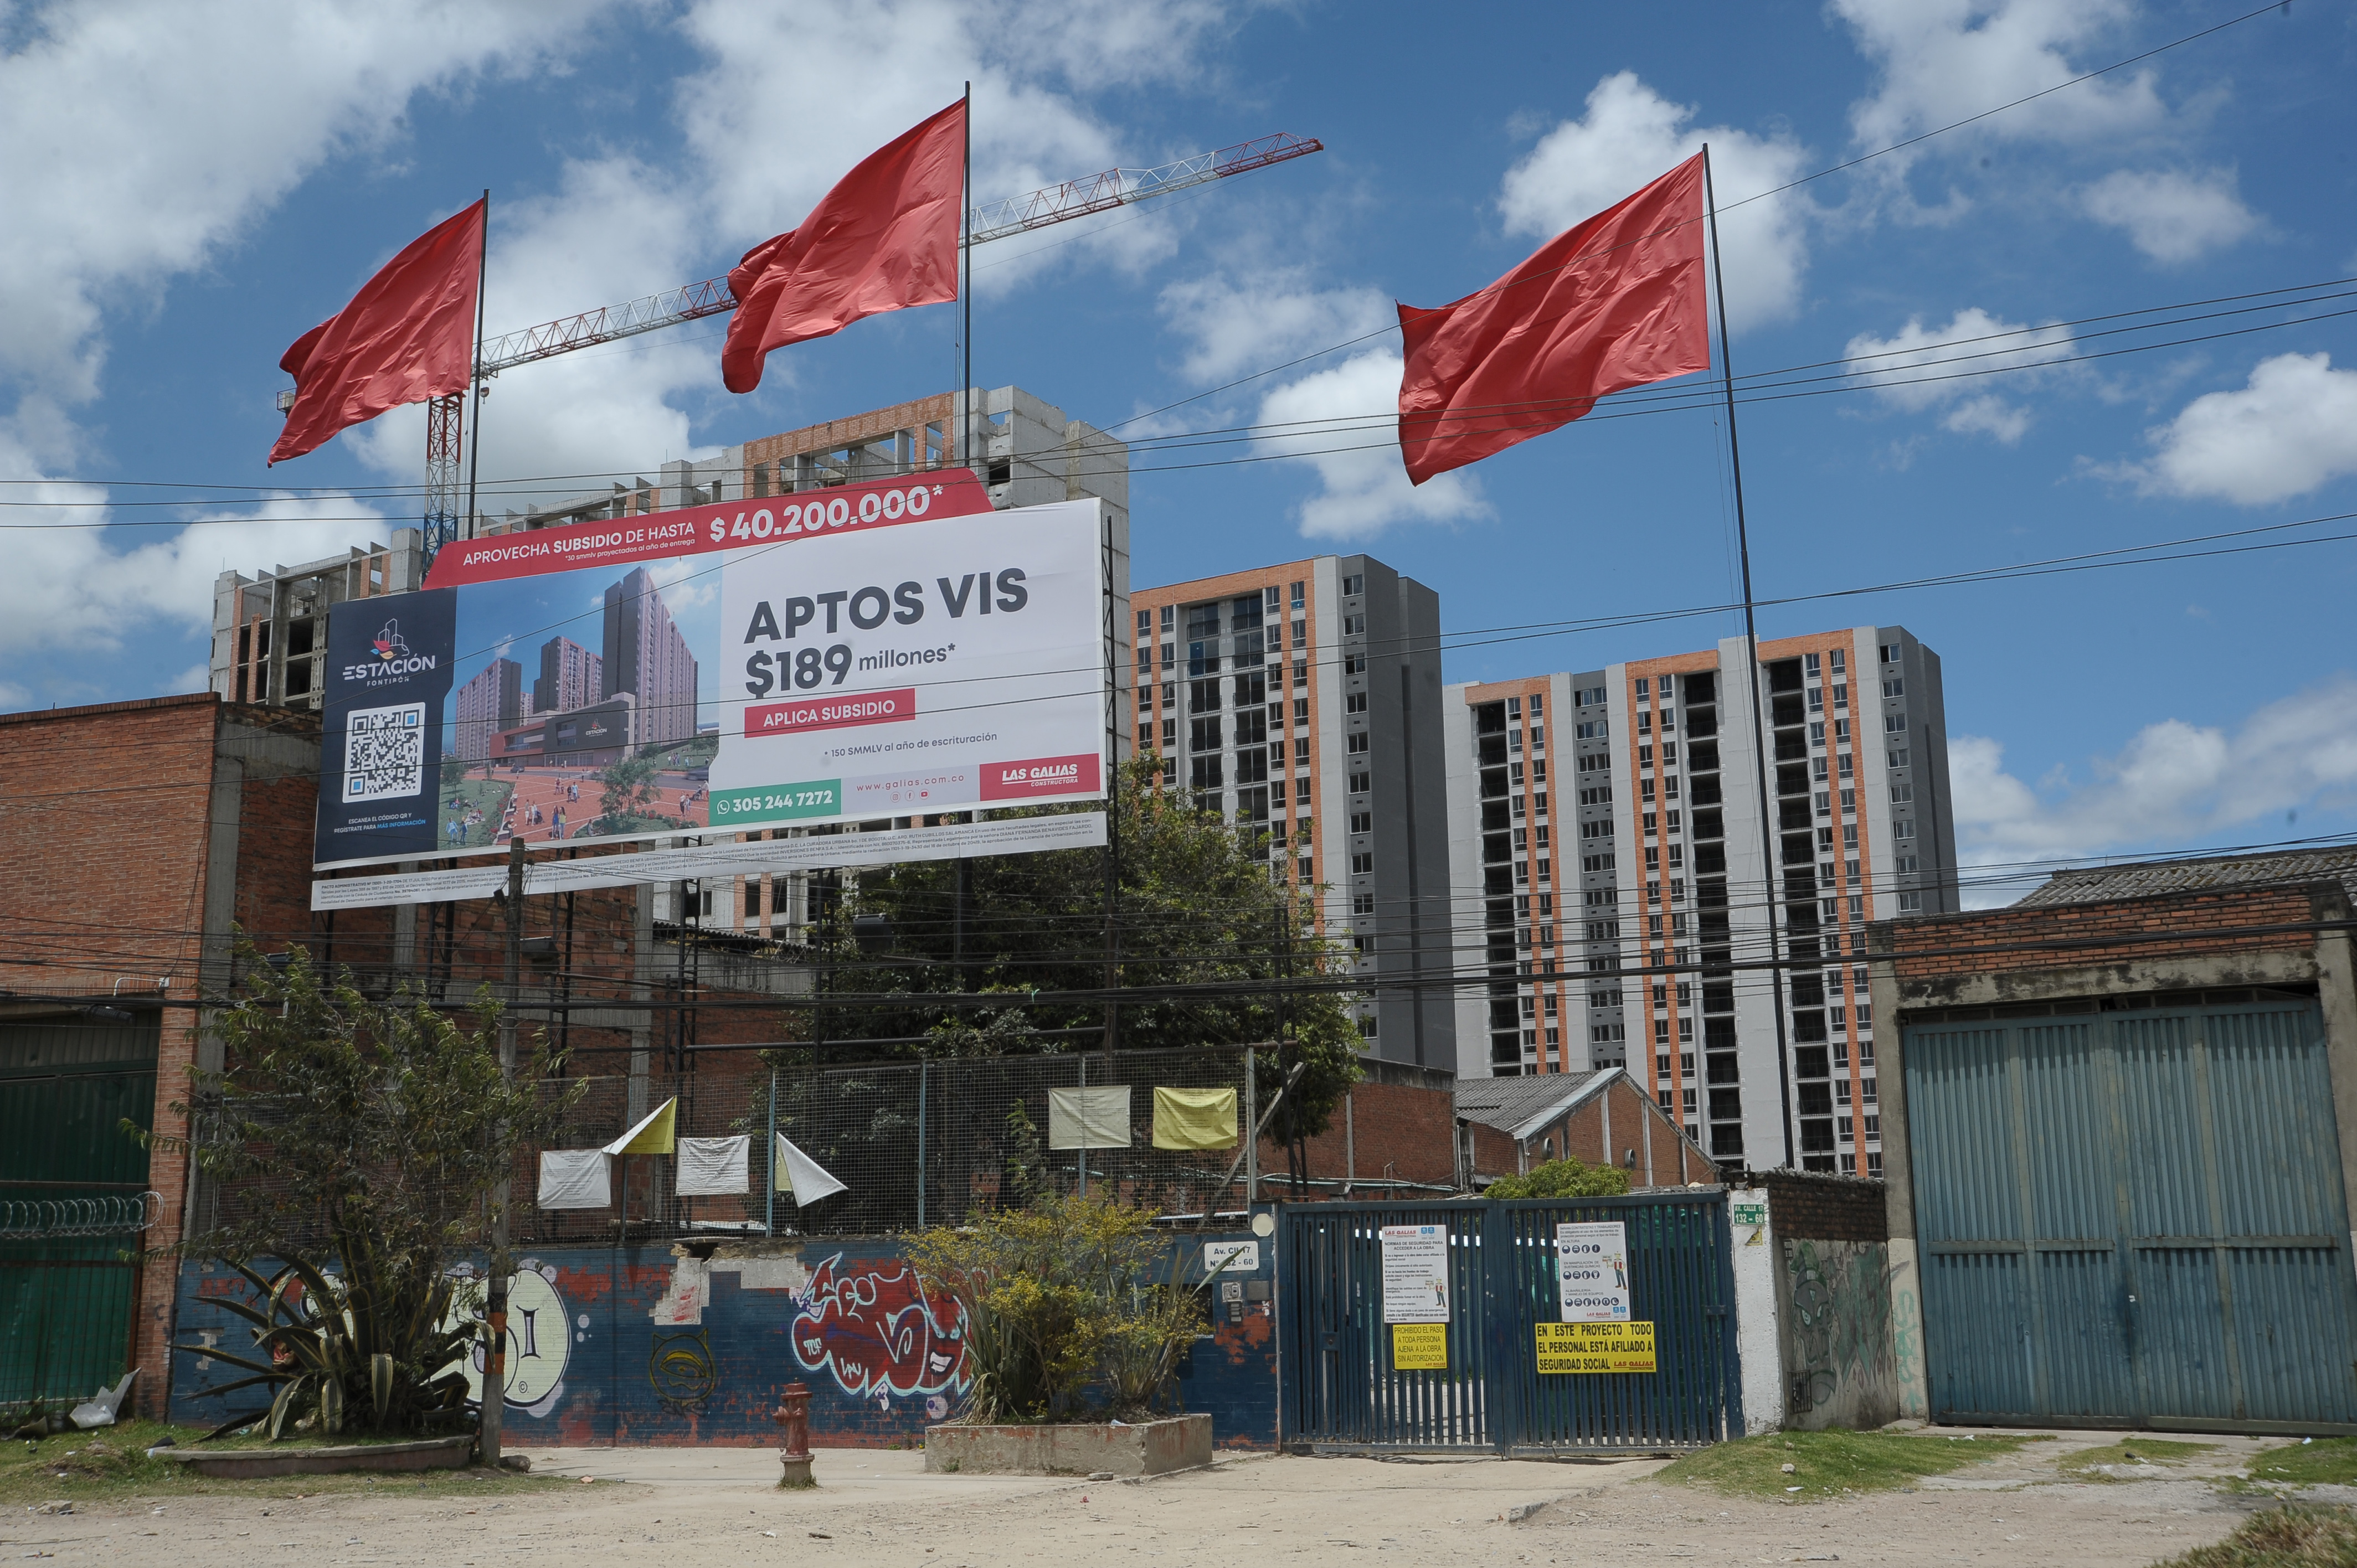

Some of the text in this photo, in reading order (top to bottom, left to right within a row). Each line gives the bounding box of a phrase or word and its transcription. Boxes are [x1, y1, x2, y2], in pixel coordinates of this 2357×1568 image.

[464, 543, 549, 565] APROVECHA
[553, 532, 621, 553] SUBSIDIO
[626, 529, 644, 543] DE
[648, 522, 694, 539] HASTA
[710, 517, 725, 542] $
[575, 551, 596, 560] smmlv
[597, 546, 637, 558] proyectados
[744, 568, 1028, 644] APTOS VIS
[343, 653, 435, 680] ESTACIÓN
[745, 644, 852, 699] $189
[367, 675, 409, 687] FONTIBÓN
[764, 700, 894, 726] APLICA SUBSIDIO
[831, 748, 845, 757] 150
[848, 744, 882, 755] SMMLV
[884, 742, 893, 751] al
[896, 741, 914, 750] año
[917, 739, 929, 747] de
[932, 733, 996, 746] escrituración
[1002, 764, 1077, 781] LAS GALIAS
[856, 774, 964, 791] www.galias.com.co
[1030, 777, 1078, 787] CONSTRUCTORA
[733, 790, 832, 812] 305 244 7272
[1735, 1214, 1747, 1223] 132
[1755, 1214, 1763, 1223] 60
[1537, 1323, 1651, 1337] EN ESTE PROYECTO TODO
[1538, 1339, 1653, 1353] EL PERSONAL ESTÁ AFILIADO A
[1539, 1358, 1610, 1370] SEGURIDAD SOCIAL
